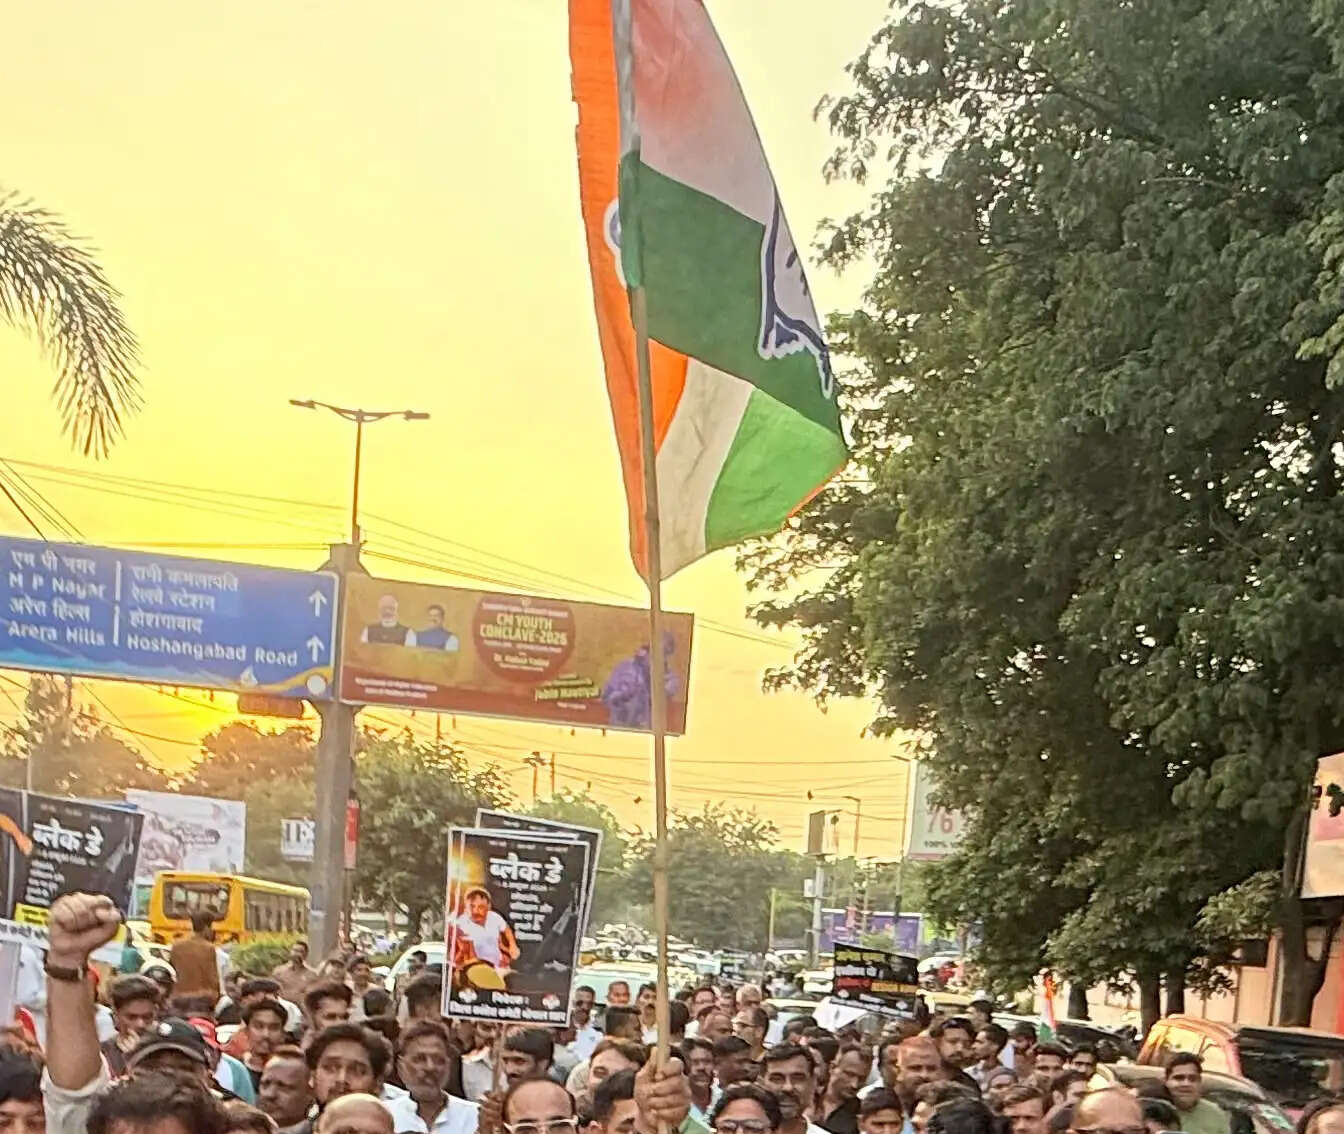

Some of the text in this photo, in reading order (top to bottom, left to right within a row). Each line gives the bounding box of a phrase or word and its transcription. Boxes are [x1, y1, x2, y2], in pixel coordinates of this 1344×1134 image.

[41, 548, 59, 573] पी
[9, 570, 106, 600] M P Nagar
[7, 620, 105, 646] Arera Hills
[515, 615, 552, 631] YOUTH
[127, 632, 299, 667] Hoshangabad Road
[32, 816, 105, 857] ब्लैक डे
[489, 852, 565, 884] ब्लैक डे
